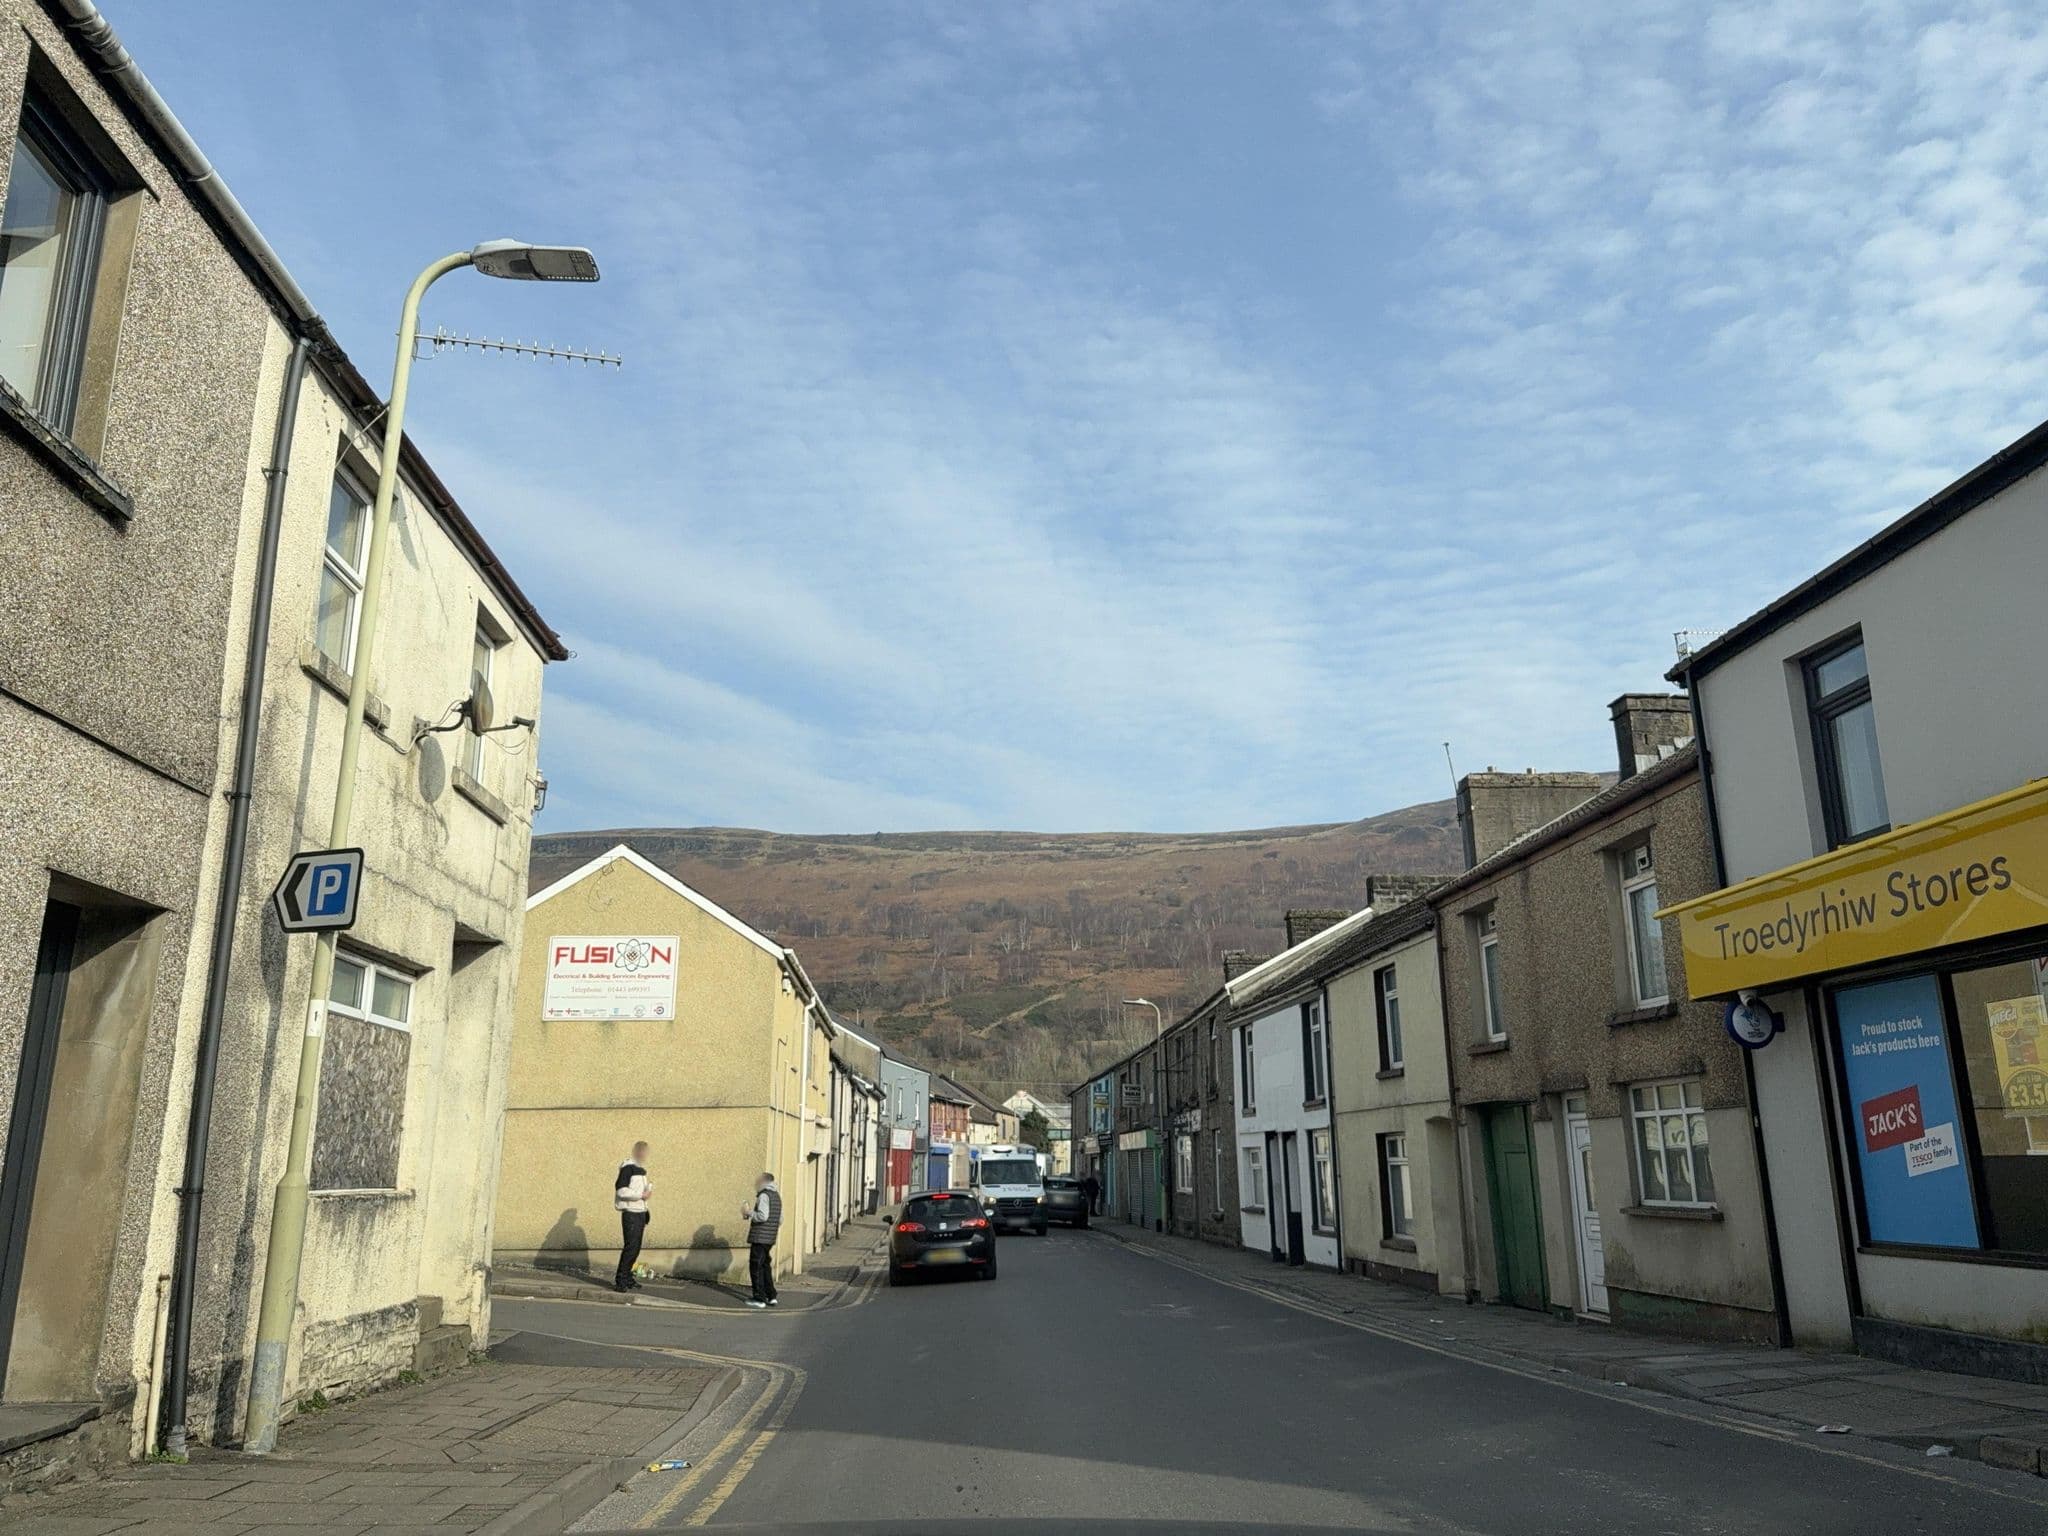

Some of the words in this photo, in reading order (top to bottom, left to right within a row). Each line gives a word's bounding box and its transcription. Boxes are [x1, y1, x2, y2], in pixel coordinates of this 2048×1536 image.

[316, 869, 343, 911] P
[1714, 889, 1876, 960] Troedyrhiw
[1887, 856, 2012, 917] Stores
[1861, 1021, 1887, 1036] Proud
[1887, 1019, 1897, 1032] to
[1898, 1016, 1923, 1032] stock
[1852, 1041, 1877, 1056] Jack's
[1878, 1035, 1918, 1056] products
[1918, 1034, 1941, 1048] here
[1869, 1103, 1917, 1136] JACK'S
[1909, 1142, 1923, 1152] Part
[1924, 1139, 1931, 1149] of
[1931, 1136, 1942, 1147] the
[1911, 1152, 1933, 1164] TESCO
[1933, 1145, 1953, 1158] family
